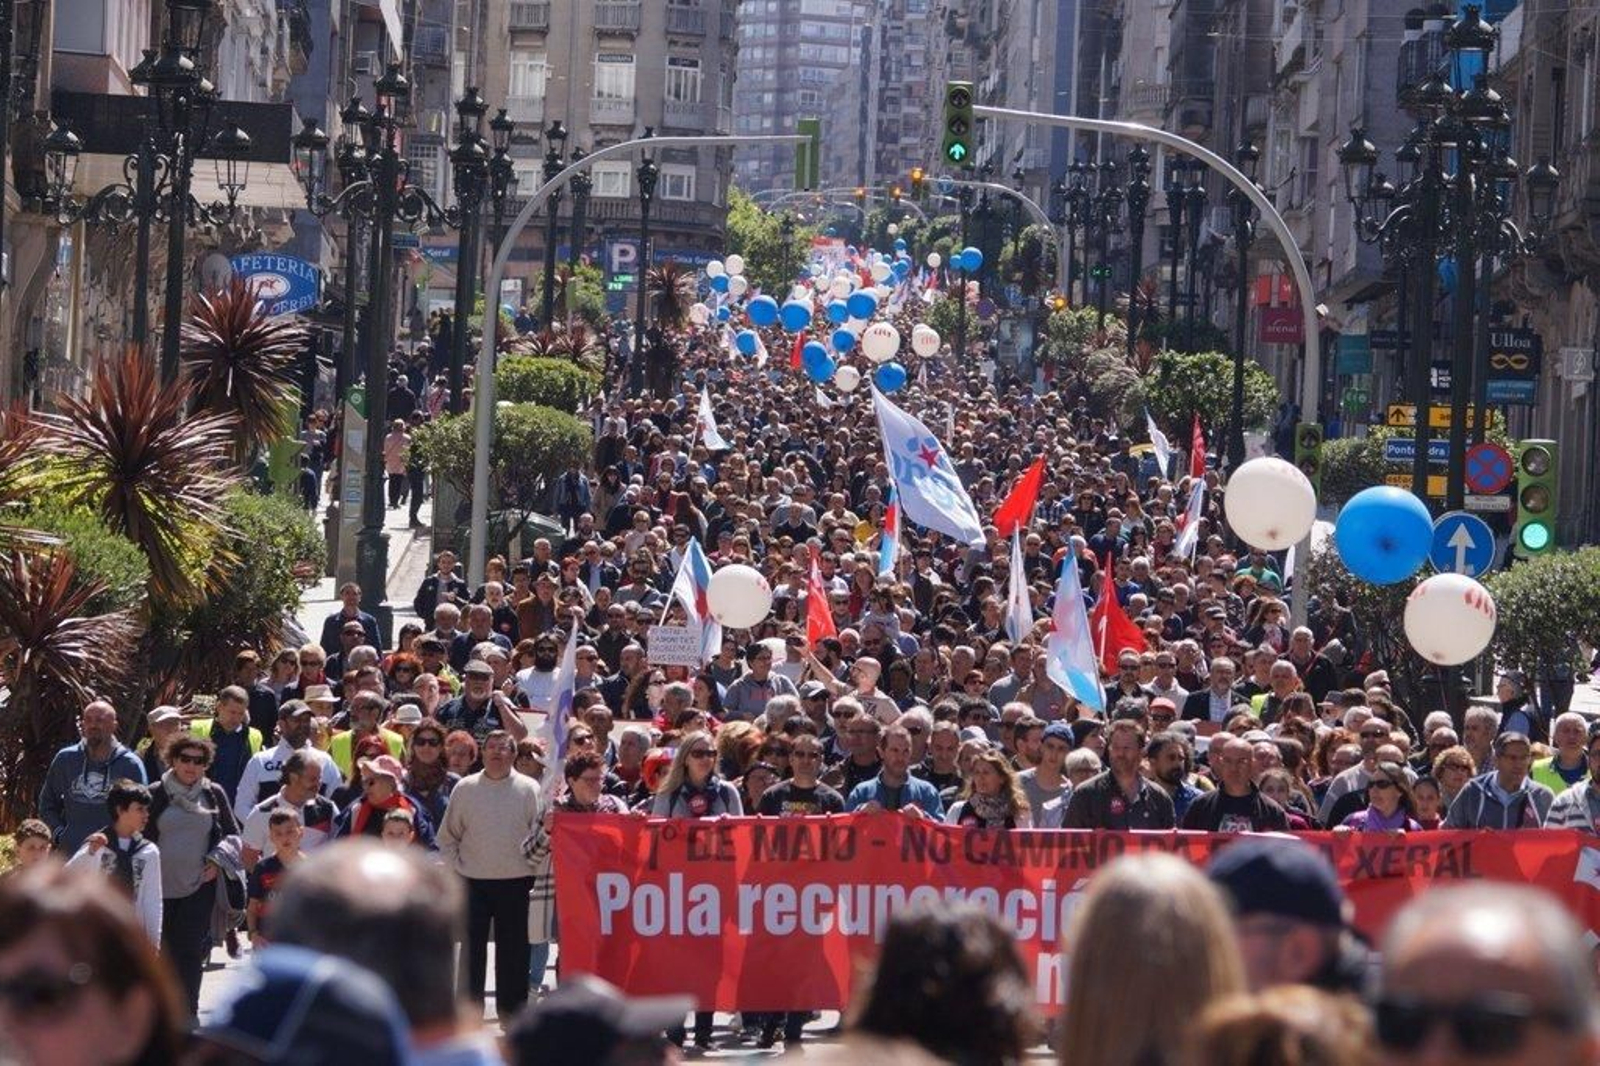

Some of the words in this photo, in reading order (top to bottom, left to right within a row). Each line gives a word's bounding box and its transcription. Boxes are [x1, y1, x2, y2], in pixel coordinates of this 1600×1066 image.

[231, 256, 315, 283] AFETERIA
[1491, 333, 1531, 348] Ulloa
[687, 824, 737, 862] DE
[752, 823, 858, 863] MAIO
[901, 825, 950, 865] NO
[1354, 841, 1483, 880] XERAL
[596, 872, 721, 937] Pola
